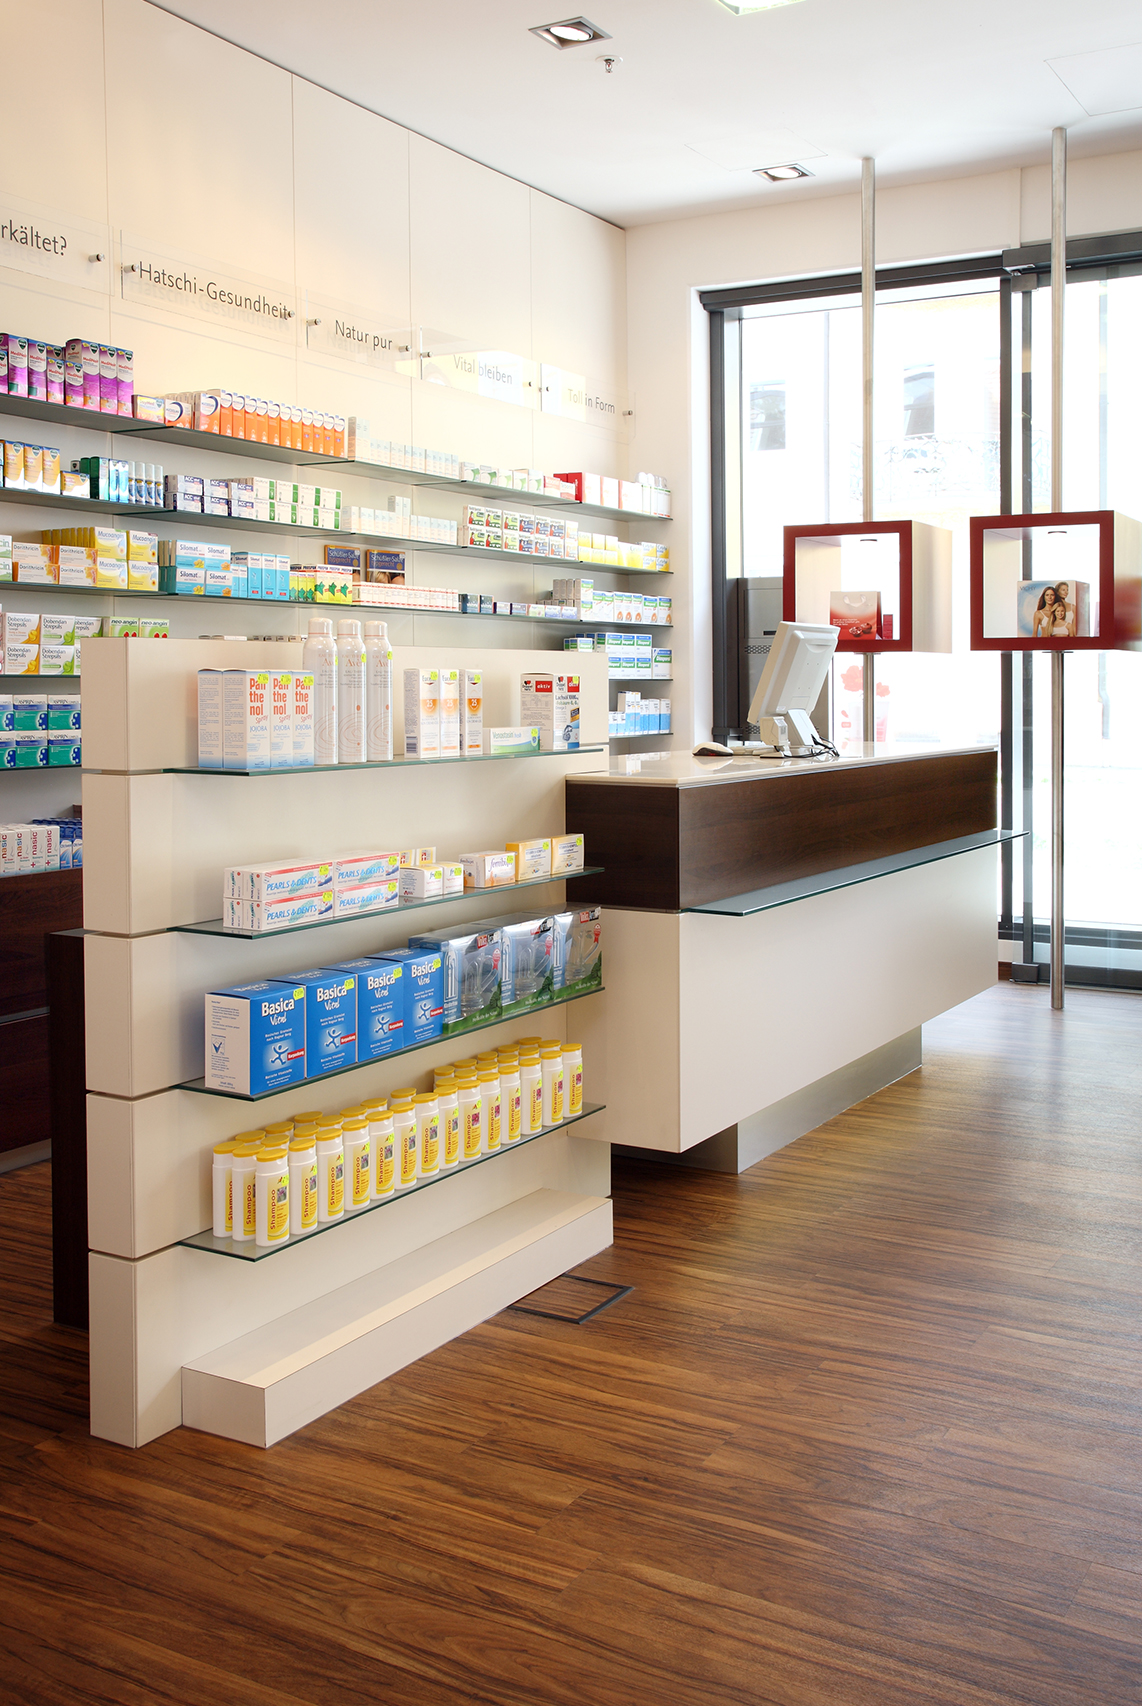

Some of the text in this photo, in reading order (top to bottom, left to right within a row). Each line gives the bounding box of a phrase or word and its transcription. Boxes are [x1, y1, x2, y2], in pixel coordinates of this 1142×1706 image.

[139, 261, 288, 321] Hatschi-Gesundheit
[334, 320, 393, 350] Natur pur
[453, 354, 513, 385] Vital bleiben
[568, 388, 616, 414] Toll in Form
[249, 691, 264, 703] the
[273, 691, 287, 702] the
[295, 691, 309, 702] the
[250, 704, 263, 715] nol
[273, 703, 286, 715] nol
[296, 703, 308, 714] nol
[338, 865, 385, 879] PEARLS & DENTS
[266, 876, 317, 891] PEARLS & DENTS
[339, 897, 360, 907] PEARLS
[365, 892, 384, 901] DENTS
[266, 904, 317, 921] PEARLS & DENTS
[411, 962, 436, 977] Basica
[368, 973, 395, 990] Basica
[417, 974, 430, 986] Vital
[317, 984, 347, 1002] Basica
[374, 986, 389, 998] Vital
[262, 998, 295, 1017] Basica
[324, 998, 340, 1011] Vital
[270, 1012, 286, 1026] Vital
